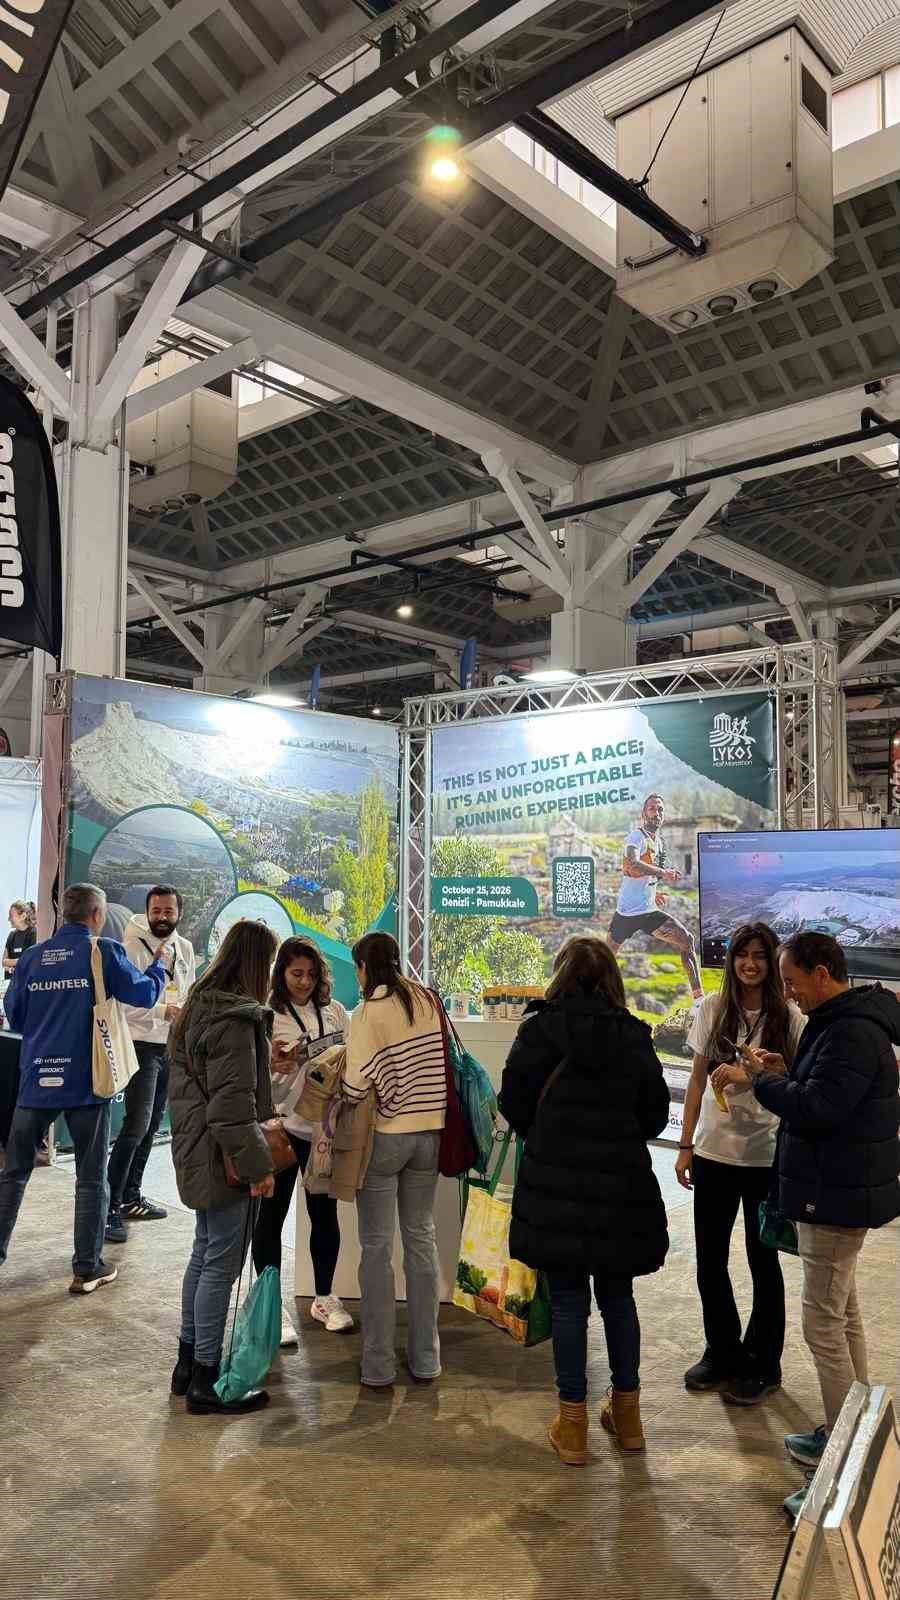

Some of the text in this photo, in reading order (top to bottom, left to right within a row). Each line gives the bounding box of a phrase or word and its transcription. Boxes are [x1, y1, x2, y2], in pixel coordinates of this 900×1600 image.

[442, 739, 644, 791] THIS IS NOT JUST A RACE;
[712, 746, 753, 761] LYKOS
[447, 762, 643, 810] IT'S AN UNFORGETTABLE
[455, 787, 635, 829] RUNNING EXPERIENCE.
[442, 886, 511, 896] October 25, 2026
[442, 897, 469, 907] Denizli
[476, 898, 525, 908] Pamukkale
